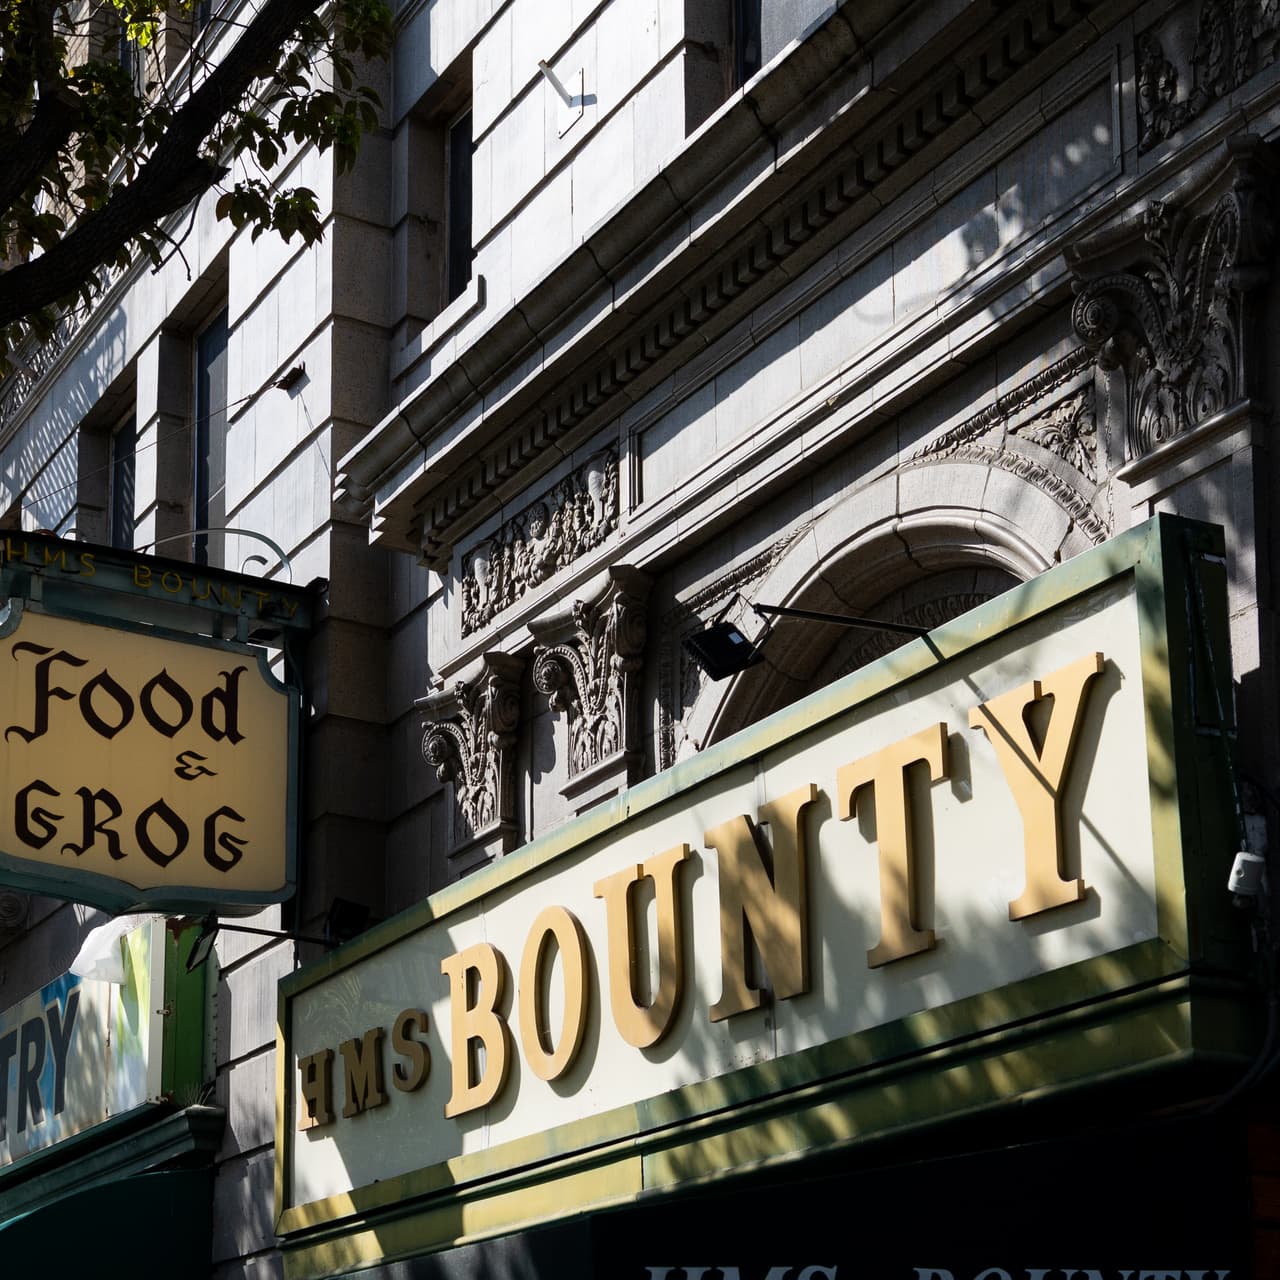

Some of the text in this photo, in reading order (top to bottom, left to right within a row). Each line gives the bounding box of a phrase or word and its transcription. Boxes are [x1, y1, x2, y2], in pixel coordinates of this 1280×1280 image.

[6, 538, 299, 618] HMS BOUNTY
[4, 640, 249, 745] Food
[174, 750, 218, 781] &
[14, 779, 249, 873] GROG
[297, 652, 1104, 1131] HMS BOUNTY
